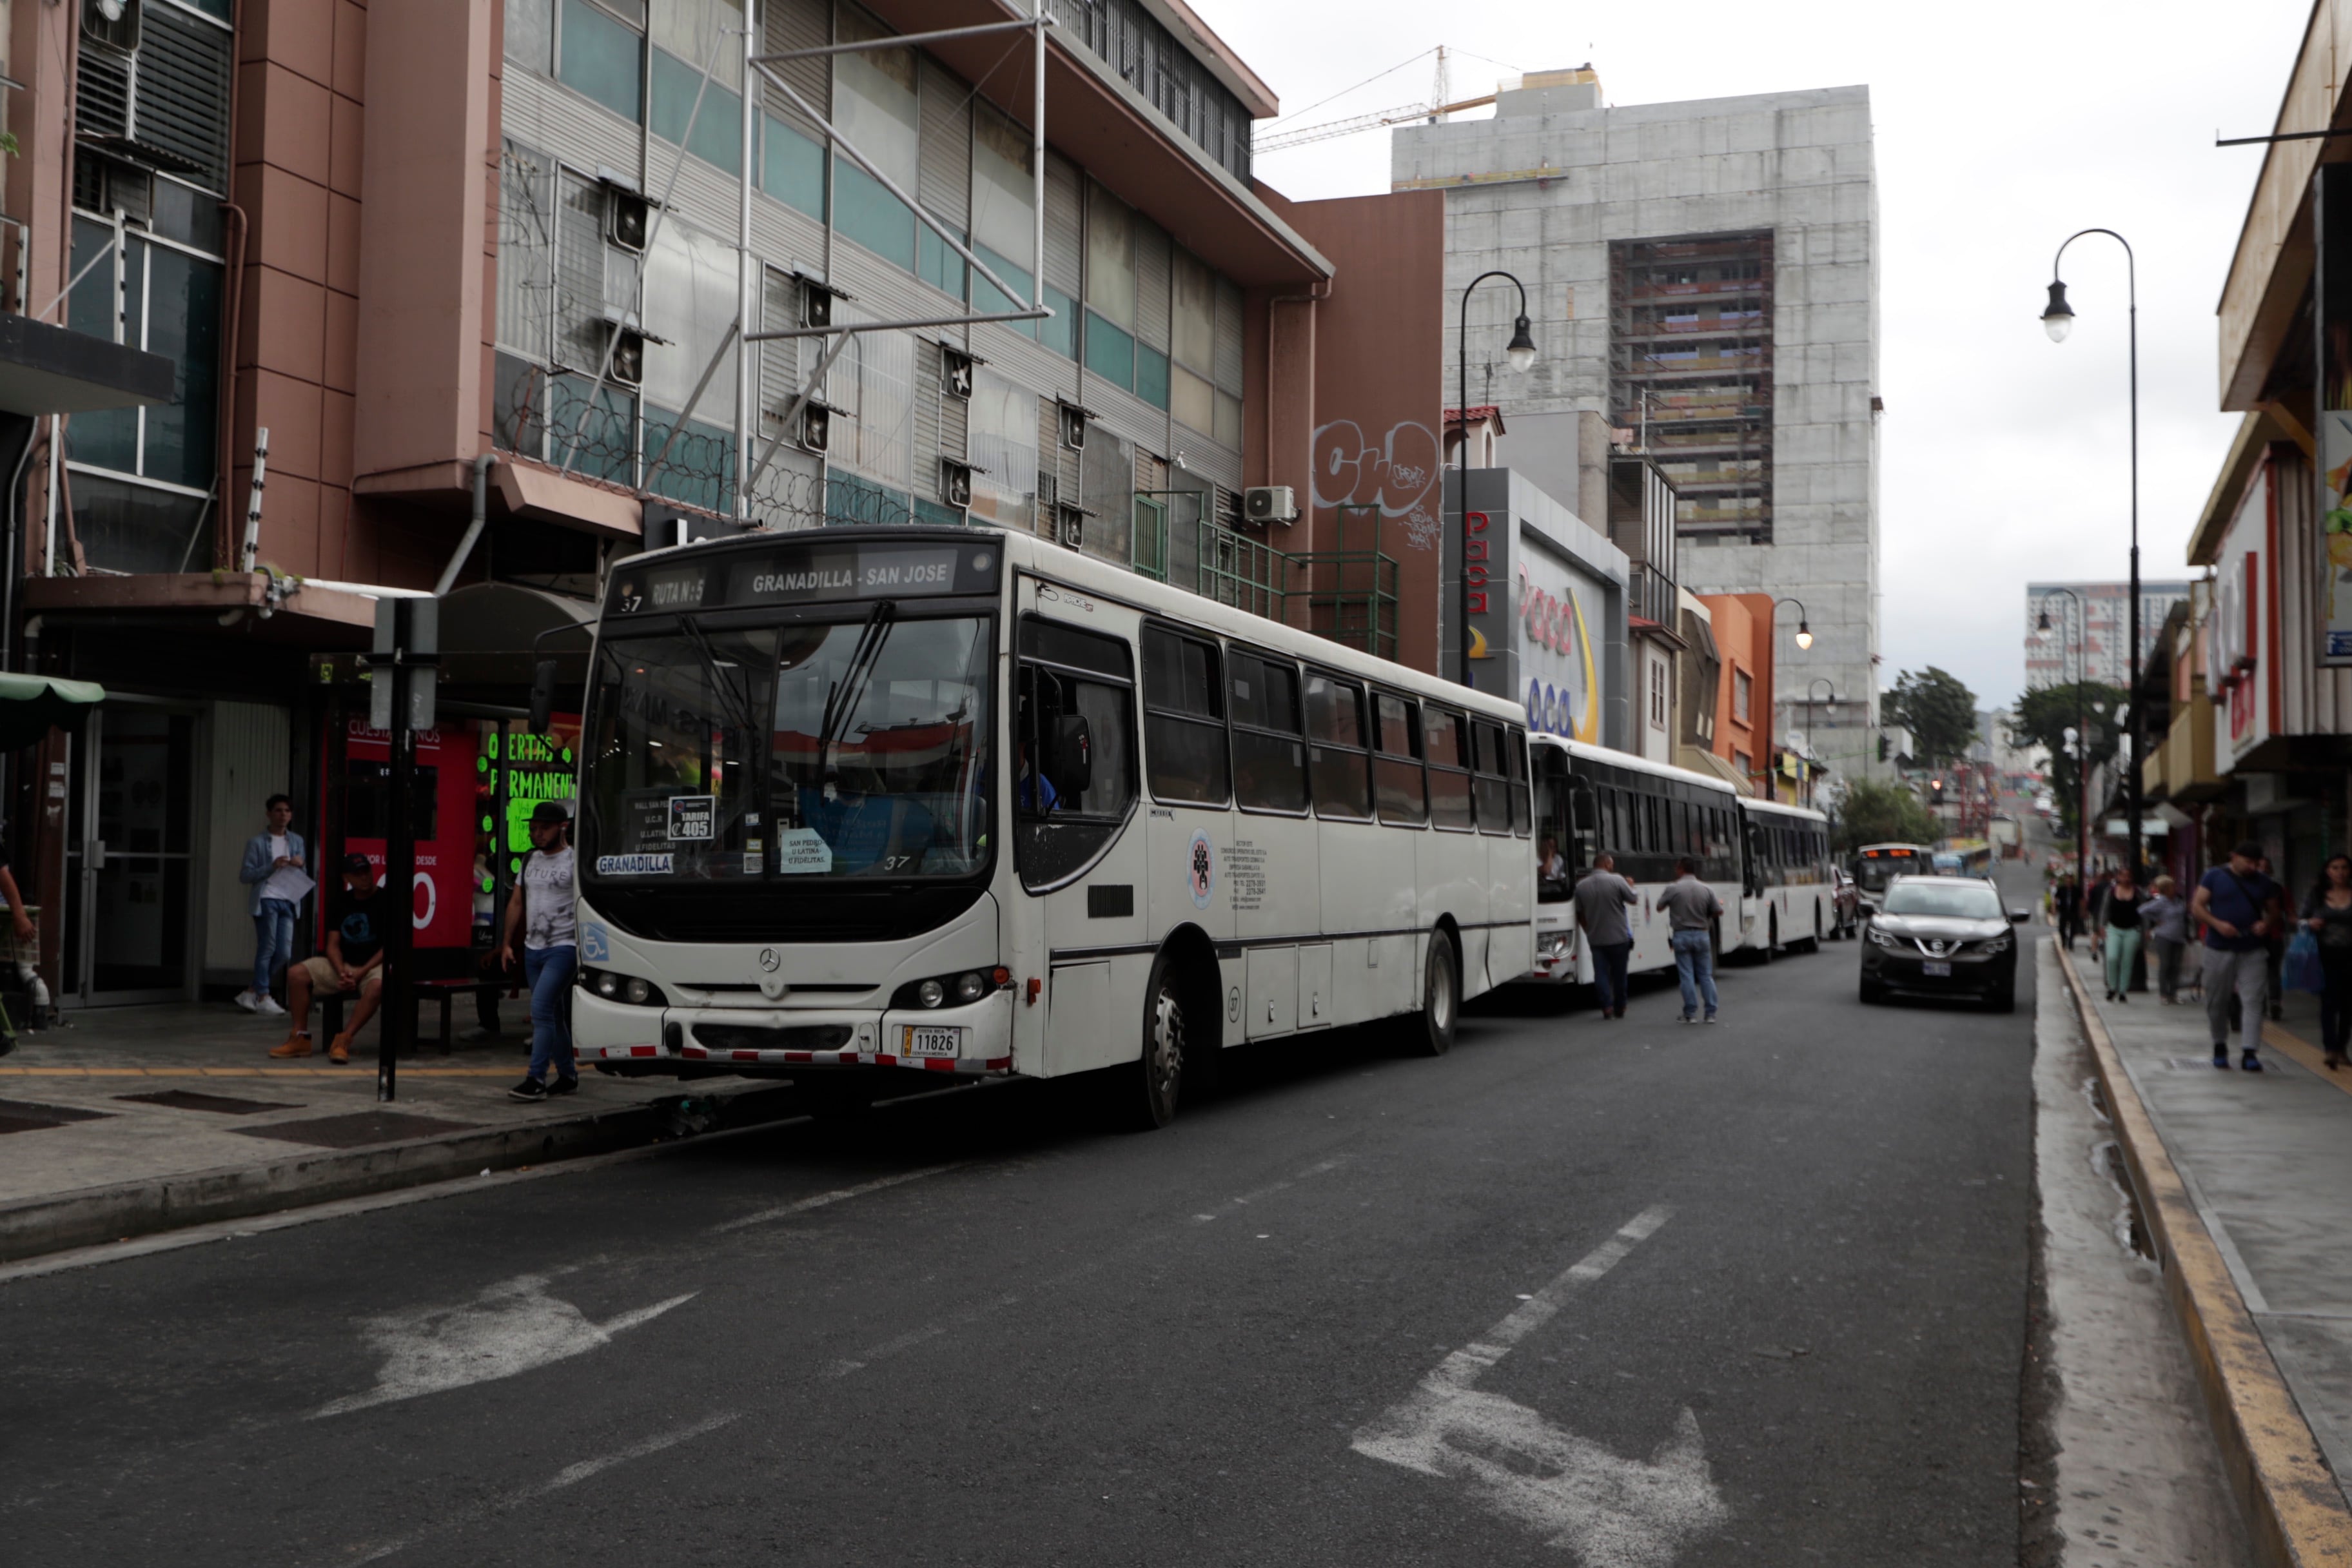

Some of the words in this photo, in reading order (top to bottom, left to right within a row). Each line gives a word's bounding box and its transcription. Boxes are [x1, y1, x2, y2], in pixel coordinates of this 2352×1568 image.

[752, 570, 853, 593] GRANADILLA
[866, 567, 900, 585] SAN
[904, 564, 948, 584] JOSE
[652, 582, 679, 605] RUTA
[621, 595, 643, 612] 37
[488, 732, 554, 763] OERTAS
[681, 811, 710, 822] TARIFA
[416, 855, 437, 866] DESDE
[600, 856, 671, 872] GRANADILLA
[884, 856, 910, 871] 37
[1230, 997, 1238, 1012] 37
[917, 1034, 954, 1051] 11826
